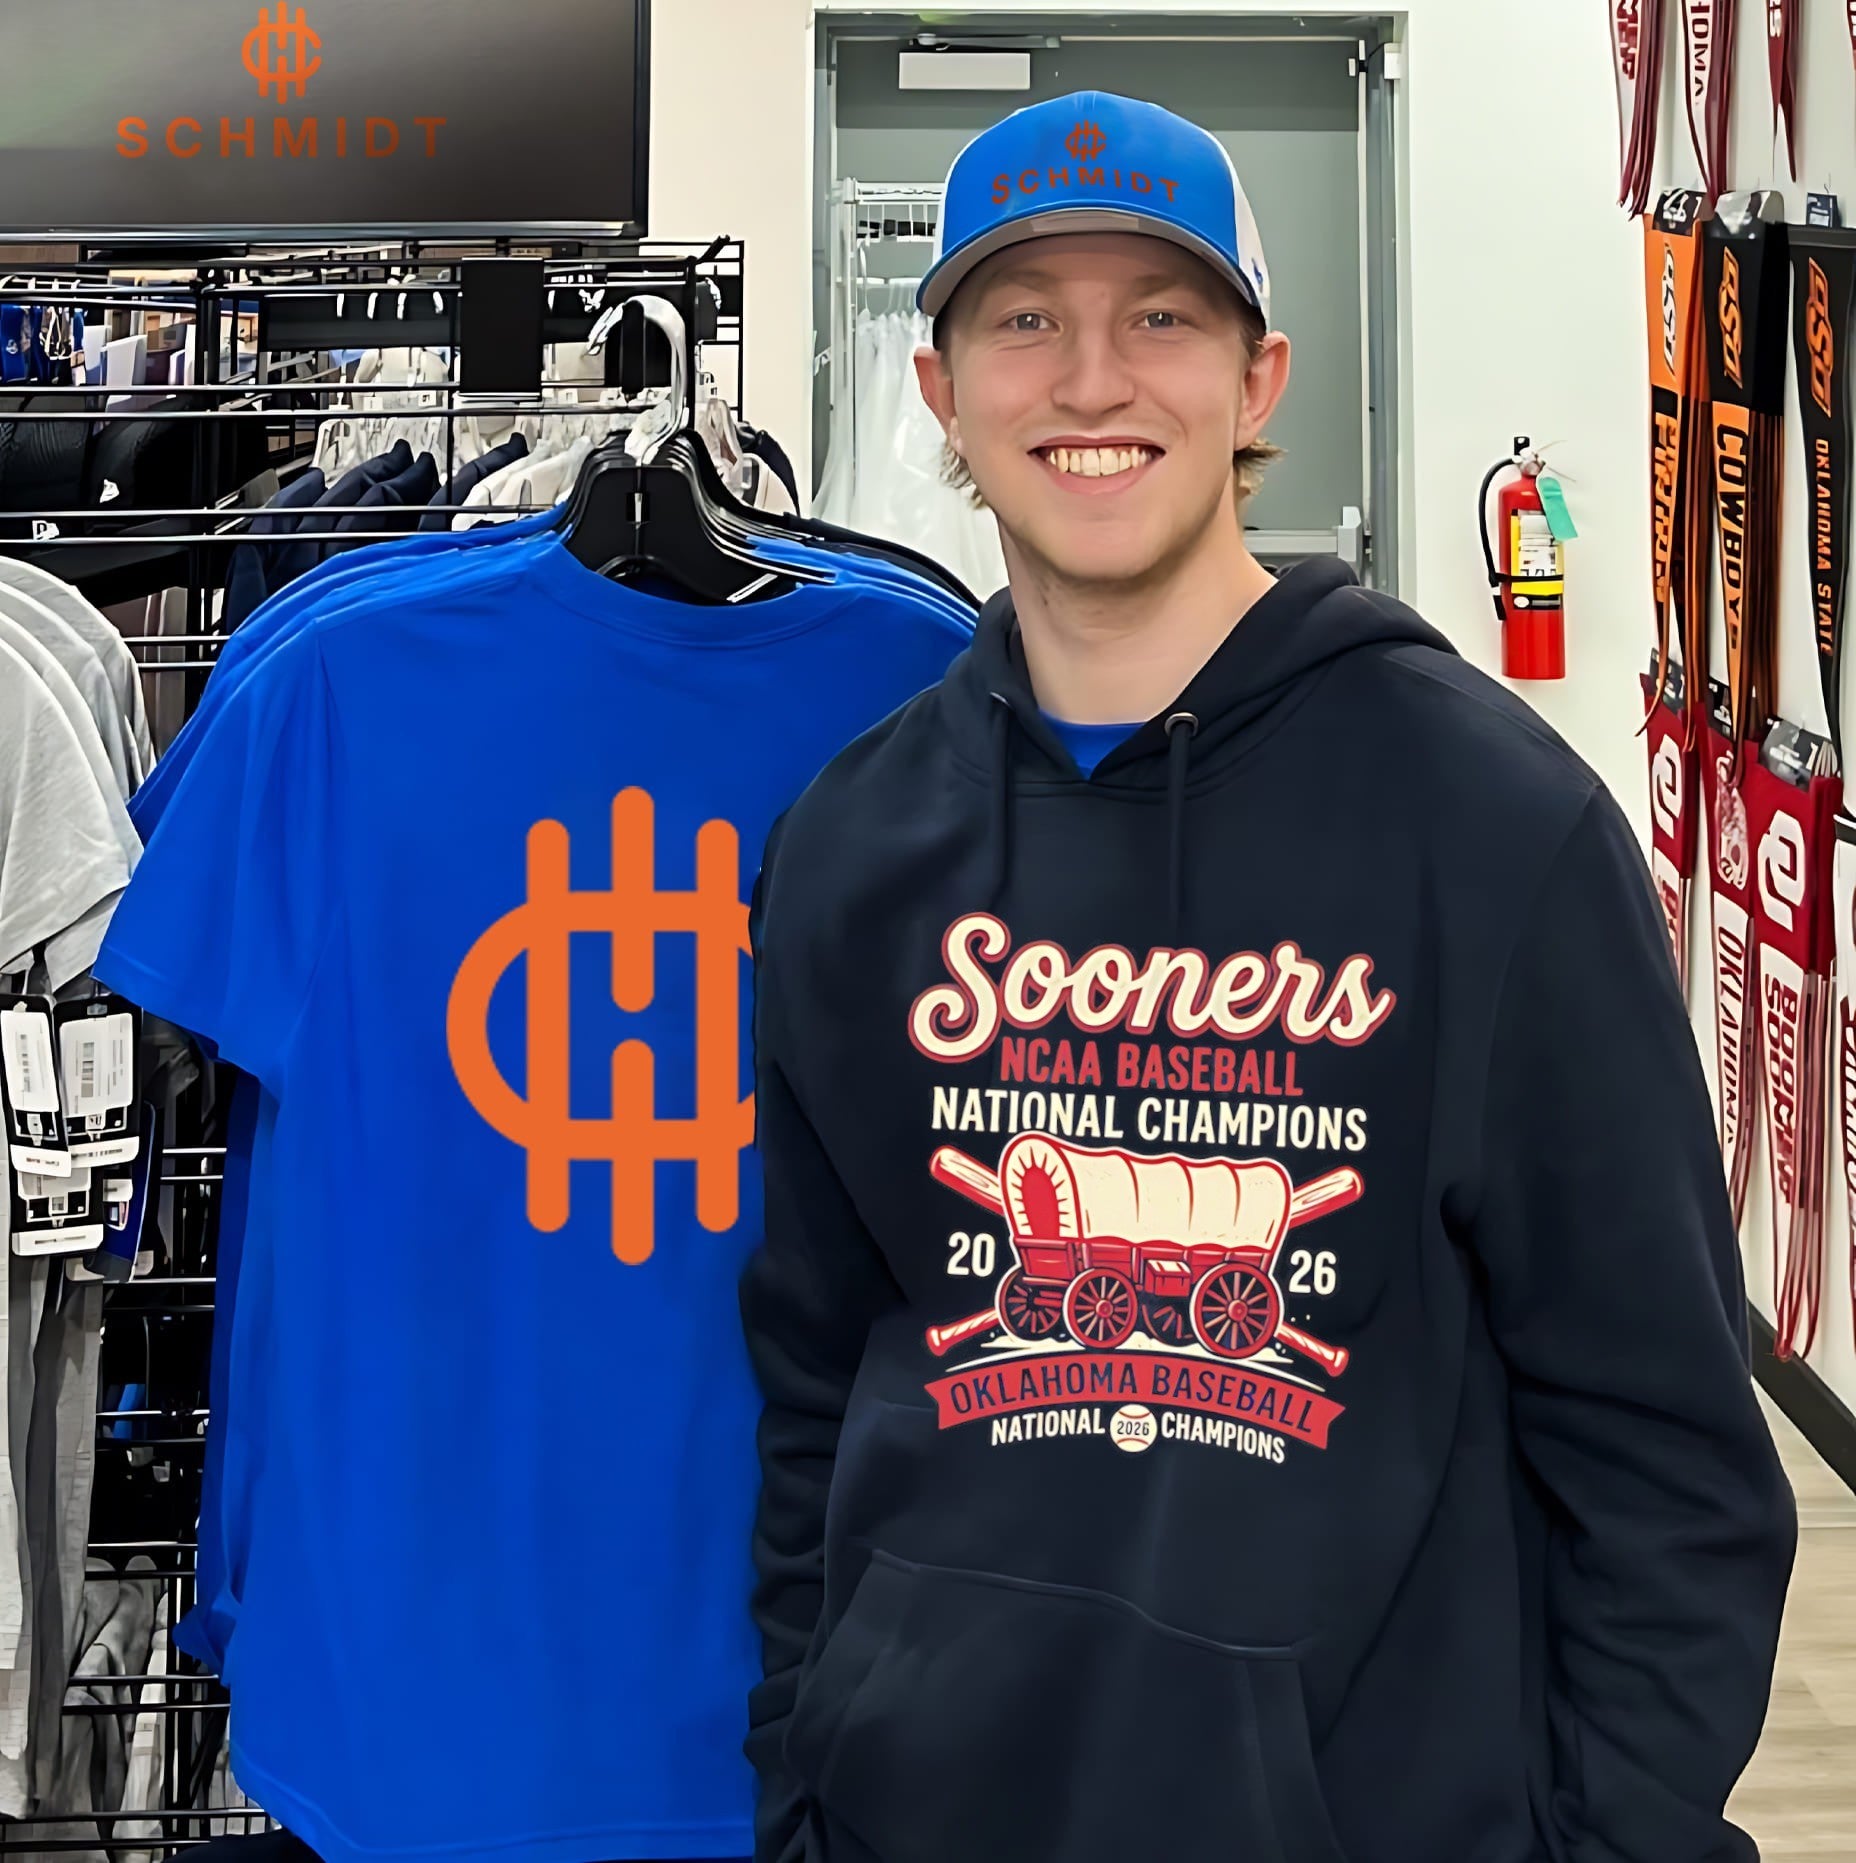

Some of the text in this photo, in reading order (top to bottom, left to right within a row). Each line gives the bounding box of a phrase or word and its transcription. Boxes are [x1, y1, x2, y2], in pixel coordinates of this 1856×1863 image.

[115, 116, 448, 159] SCHMIDT
[991, 167, 1179, 205] SCHMIDT
[908, 912, 1397, 1063] Sooners
[1001, 1036, 1303, 1096] NCAA BASEBALL
[931, 1086, 1368, 1152] NATIONAL CHAMPIONS
[946, 1232, 995, 1278] 20
[1289, 1250, 1336, 1295] 26
[950, 1362, 1312, 1433] OKLAHOMA BASEBALL
[991, 1408, 1285, 1464] NATIONAL 2026 CHAMPIONS
